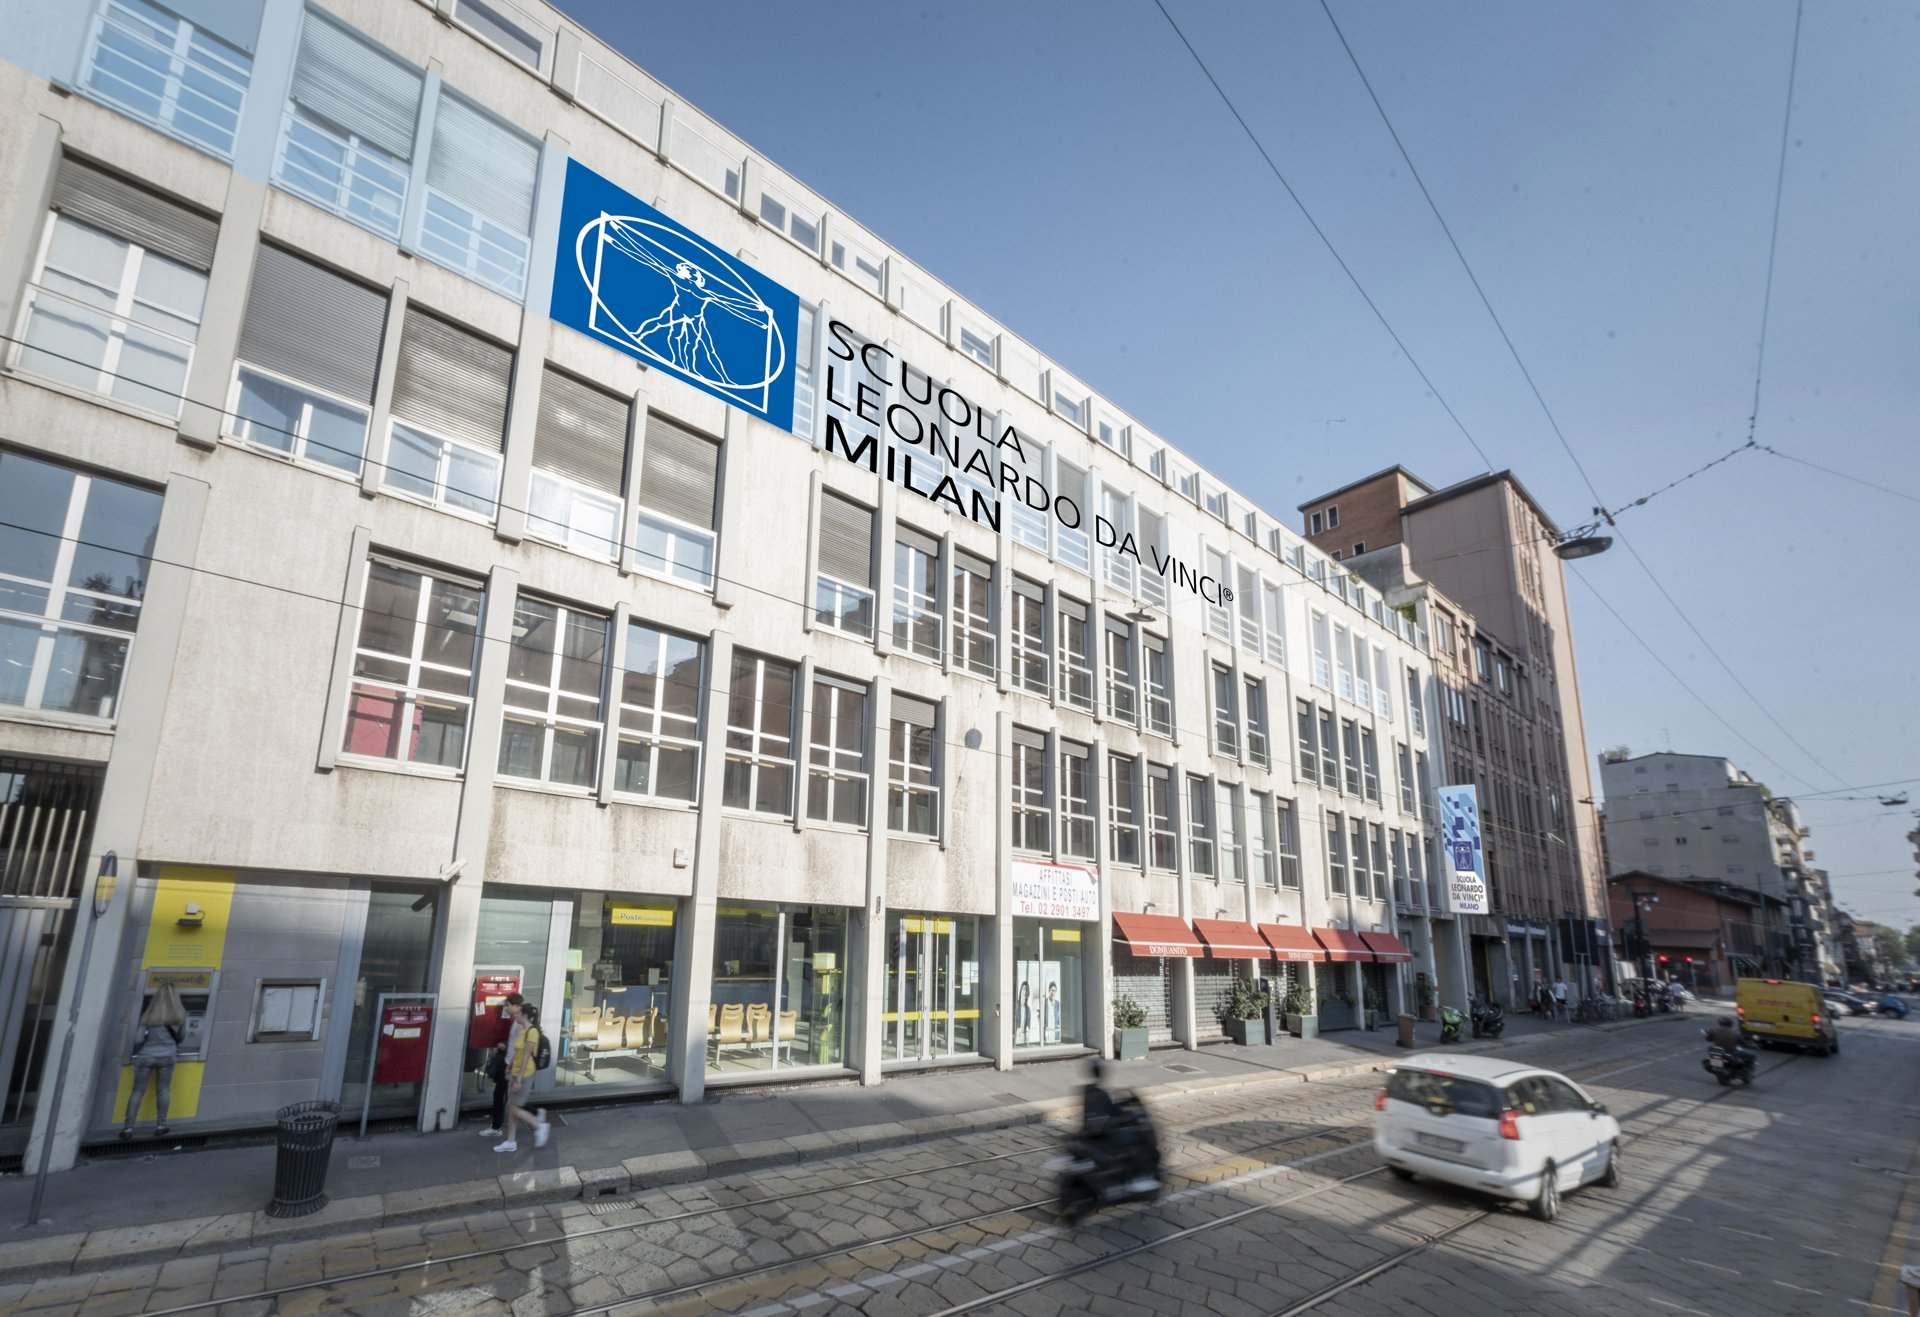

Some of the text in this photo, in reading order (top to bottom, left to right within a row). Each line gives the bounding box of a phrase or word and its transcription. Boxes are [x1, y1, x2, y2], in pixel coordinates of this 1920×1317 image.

[1040, 868, 1073, 886] AFFITTASI
[1456, 875, 1477, 883] SCUOLA
[1012, 881, 1096, 905] MAGAZZINI E POSTI AUTO
[1451, 883, 1484, 893] LEONARDO
[1453, 892, 1461, 900] DA
[1020, 900, 1090, 918] Tel. 02 2901 3497
[1459, 902, 1479, 910] MILANO
